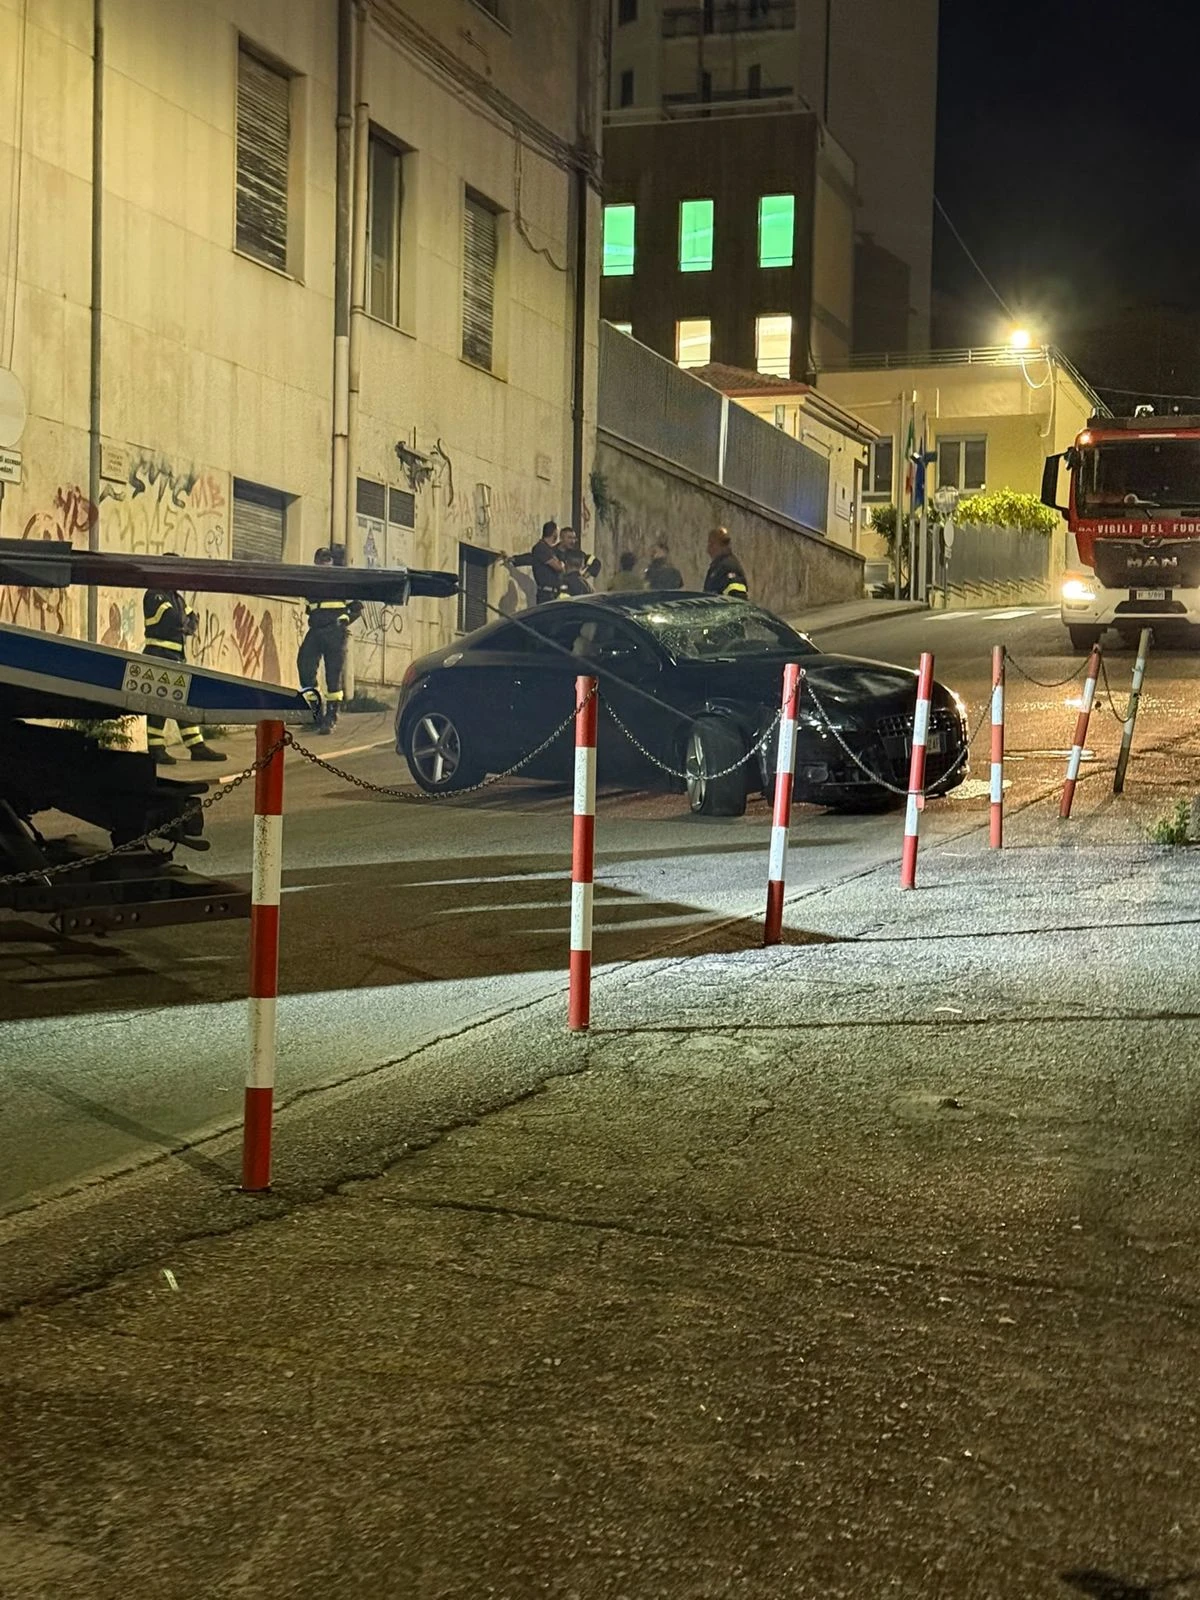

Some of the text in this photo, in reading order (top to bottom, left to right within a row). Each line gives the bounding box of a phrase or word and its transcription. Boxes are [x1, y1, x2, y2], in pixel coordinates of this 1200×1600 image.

[1097, 523, 1133, 533] VIGILI
[1141, 523, 1164, 533] DEL
[1126, 555, 1178, 567] MAN
